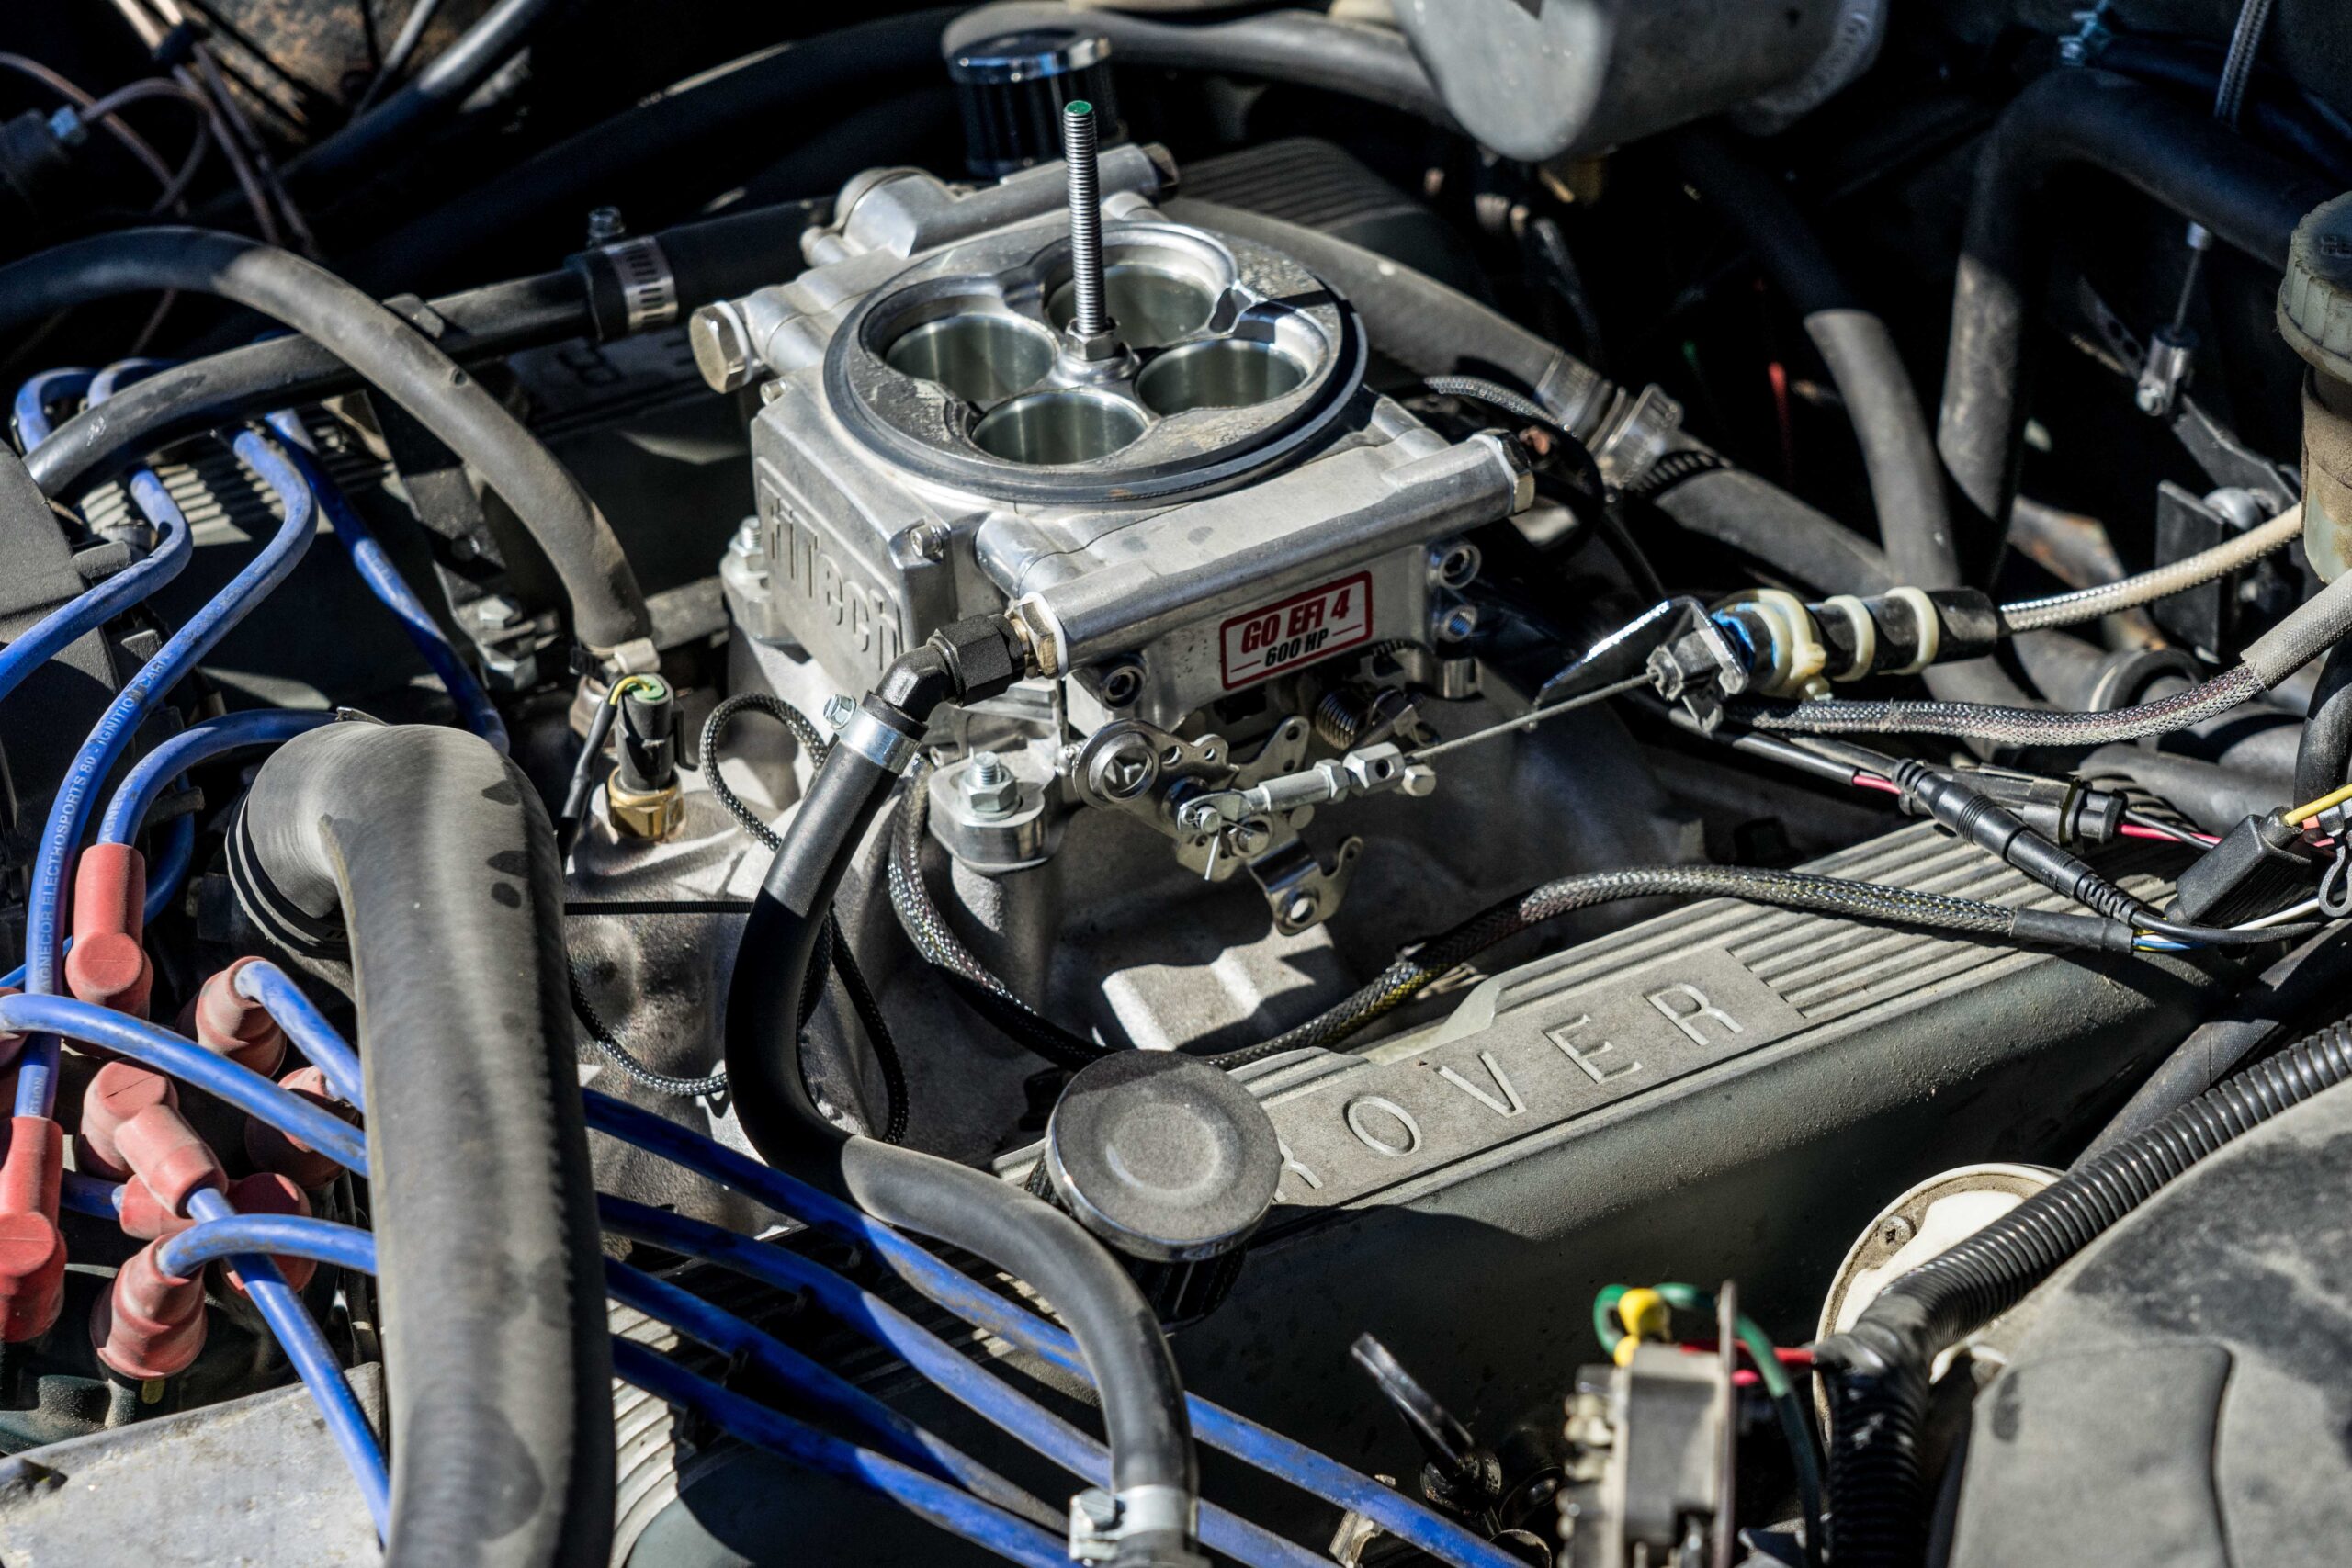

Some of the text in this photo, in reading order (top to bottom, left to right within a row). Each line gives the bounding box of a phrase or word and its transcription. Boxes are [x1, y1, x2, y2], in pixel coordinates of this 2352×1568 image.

[1241, 588, 1351, 654] GO EFI 4
[1265, 628, 1329, 667] 600 HP
[96, 688, 143, 745] IGNITION
[79, 756, 96, 773] 80
[42, 774, 86, 907] ELECTROSPORTS
[38, 908, 54, 992] AGNECOR
